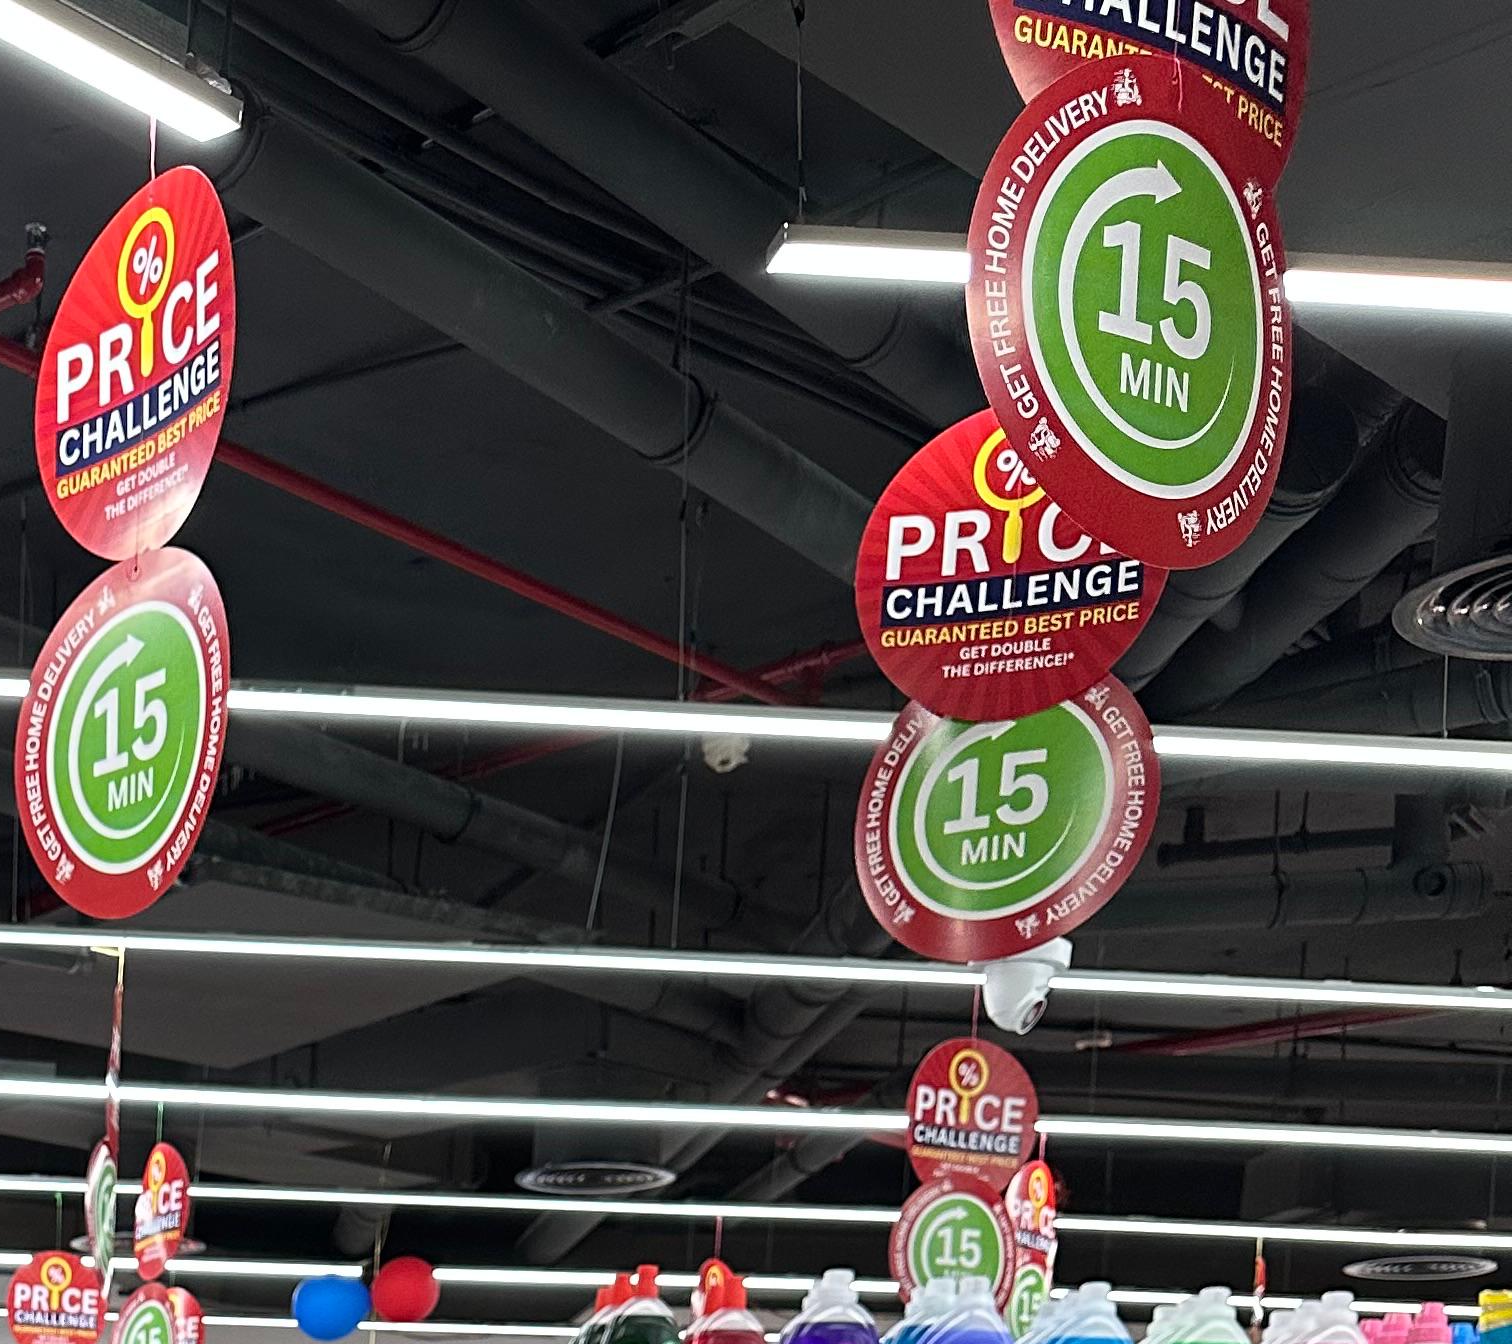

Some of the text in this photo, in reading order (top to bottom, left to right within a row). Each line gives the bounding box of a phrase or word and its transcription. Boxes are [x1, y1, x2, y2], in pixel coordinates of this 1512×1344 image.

[1060, 0, 1286, 103] ALLENGE
[1237, 94, 1283, 148] PRICE
[984, 87, 1109, 418] GET FREE HOME DELIVERY
[1098, 220, 1212, 360] 15
[56, 249, 220, 425] PRICE
[59, 340, 220, 466] CHALLENGE
[1119, 352, 1189, 413] MIN
[1205, 222, 1284, 535] GET FREE HOME DELIVERY
[57, 390, 221, 499] GUARANTEED BEST PRICE
[117, 451, 175, 496] GET DOUBLE
[104, 499, 126, 521] THE
[886, 559, 1139, 621] CHALLENGE
[880, 602, 1139, 648] GUARANTEED BEST PRICE
[959, 638, 1051, 660] GET DOUBLE
[942, 662, 971, 678] THE
[25, 611, 96, 861] GET FREE HOME DELIVERY
[93, 667, 167, 778] 15
[166, 606, 223, 872] GET FREE HOME DELIVERY
[106, 766, 153, 813] MIN
[866, 767, 893, 828] HOME
[943, 748, 1049, 836] 15
[1046, 706, 1145, 925] GET FREE HOME DELIVERY
[866, 829, 885, 876] FREE
[961, 831, 1026, 864] MIN
[874, 876, 901, 906] GET
[914, 1124, 1020, 1154] CHALLENGE
[915, 1084, 1026, 1133] PRICE
[935, 1227, 983, 1268] 15
[13, 1282, 99, 1314] PRICE
